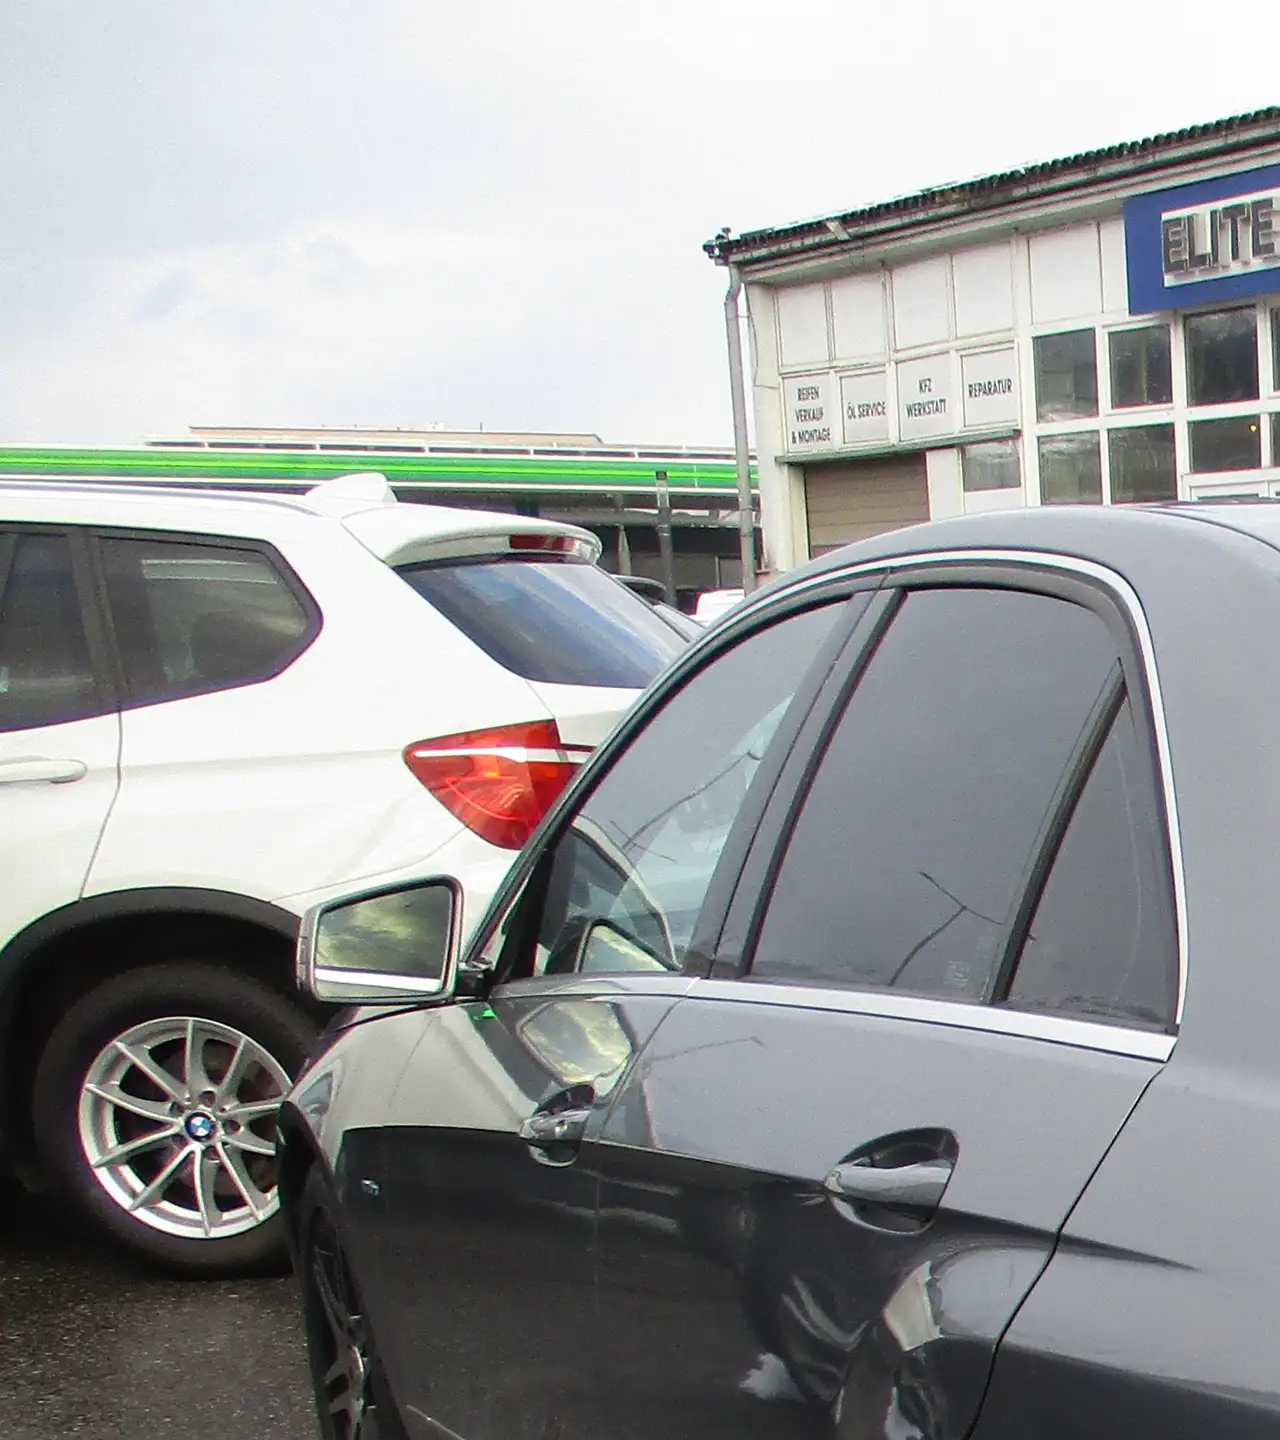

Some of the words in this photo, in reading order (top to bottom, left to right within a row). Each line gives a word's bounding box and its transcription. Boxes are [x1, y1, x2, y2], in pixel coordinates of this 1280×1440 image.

[797, 386, 820, 401] REIFEN
[919, 378, 932, 393] KFZ
[968, 378, 1012, 398] REPARATUR
[795, 407, 824, 422] VERKAUF
[847, 402, 857, 420] ÖL
[858, 401, 886, 418] SERVICE
[906, 399, 947, 419] WERKSTATT
[798, 427, 831, 444] MONTAGE
